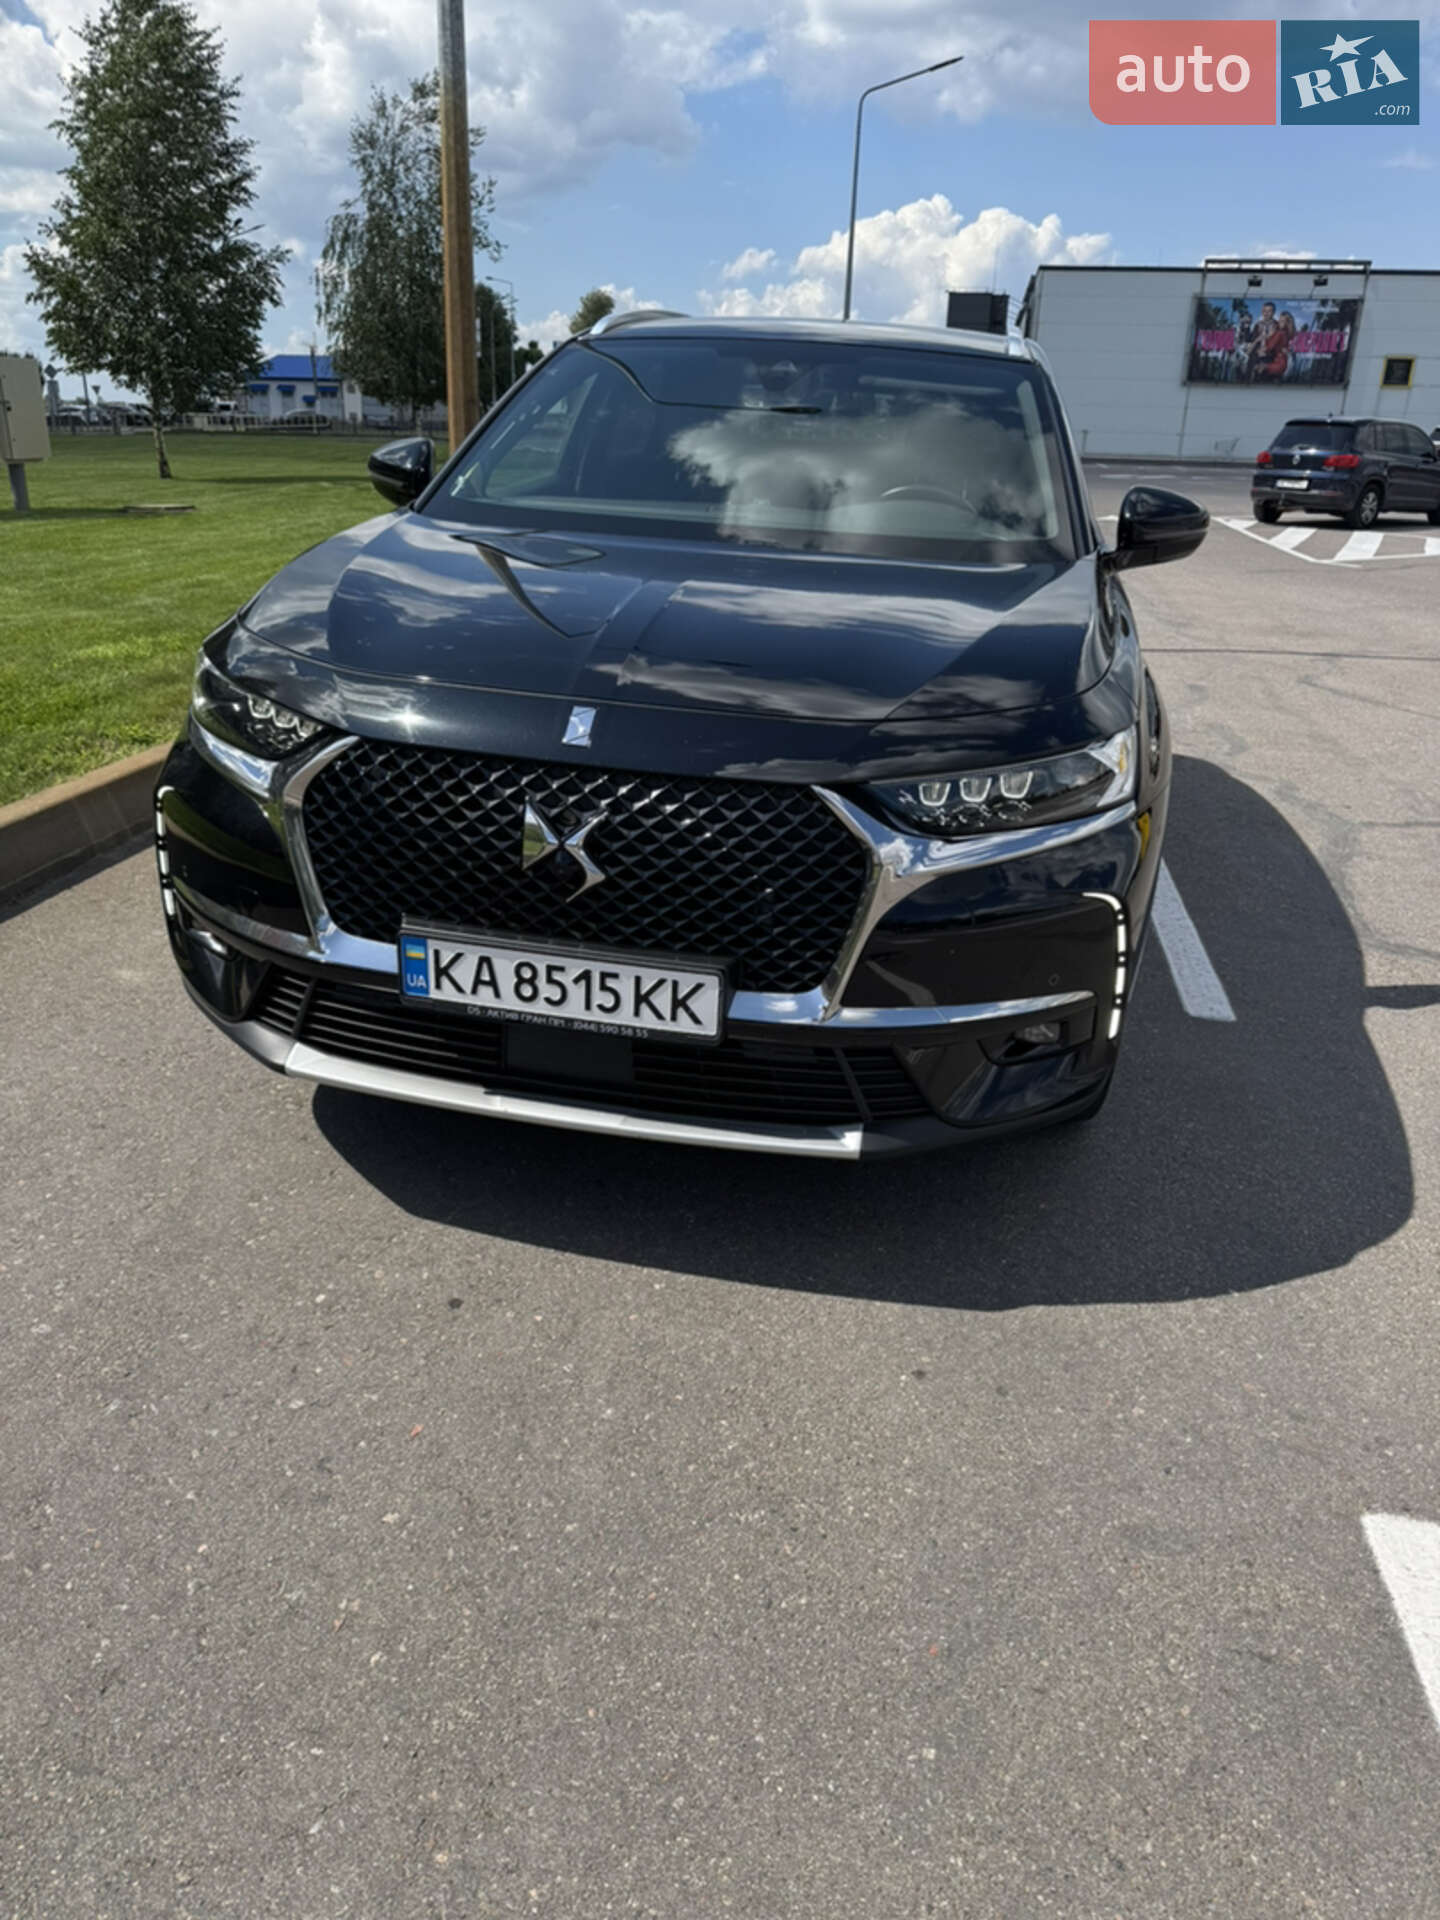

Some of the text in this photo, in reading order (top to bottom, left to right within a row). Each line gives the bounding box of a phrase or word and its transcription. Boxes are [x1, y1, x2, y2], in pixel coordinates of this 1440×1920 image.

[407, 973, 427, 989] UA
[433, 949, 706, 1026] KA 8515 KK
